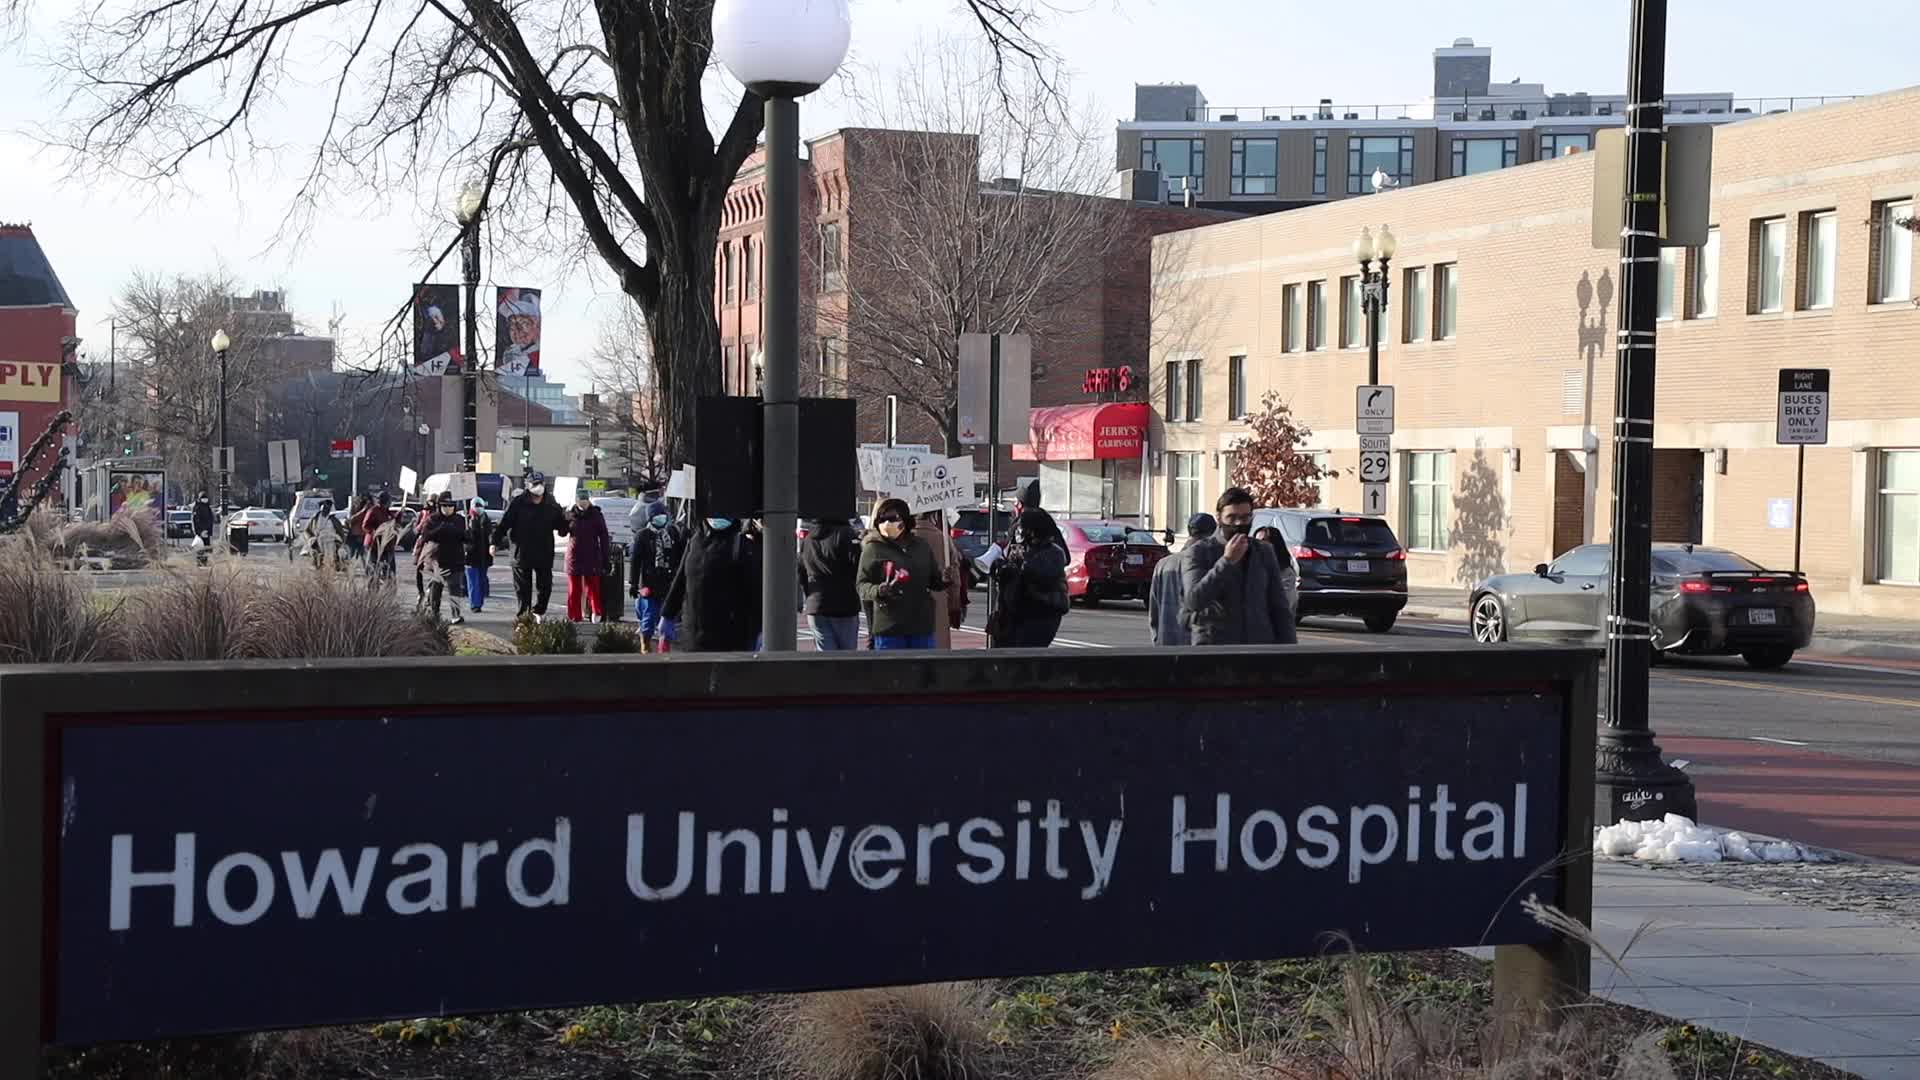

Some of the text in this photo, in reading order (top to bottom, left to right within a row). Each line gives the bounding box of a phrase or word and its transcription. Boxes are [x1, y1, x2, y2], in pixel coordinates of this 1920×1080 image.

[1794, 382, 1813, 390] LANE
[1784, 395, 1822, 405] BUSES
[1365, 408, 1386, 417] ONLY
[1785, 406, 1821, 416] BIKES
[1788, 417, 1817, 427] ONLY
[1099, 426, 1138, 437] JERRY'S
[1362, 438, 1388, 450] SOUTH
[1363, 457, 1387, 474] 29
[915, 487, 965, 508] ADVOCATE
[109, 783, 1528, 931] Howard University Hospital
